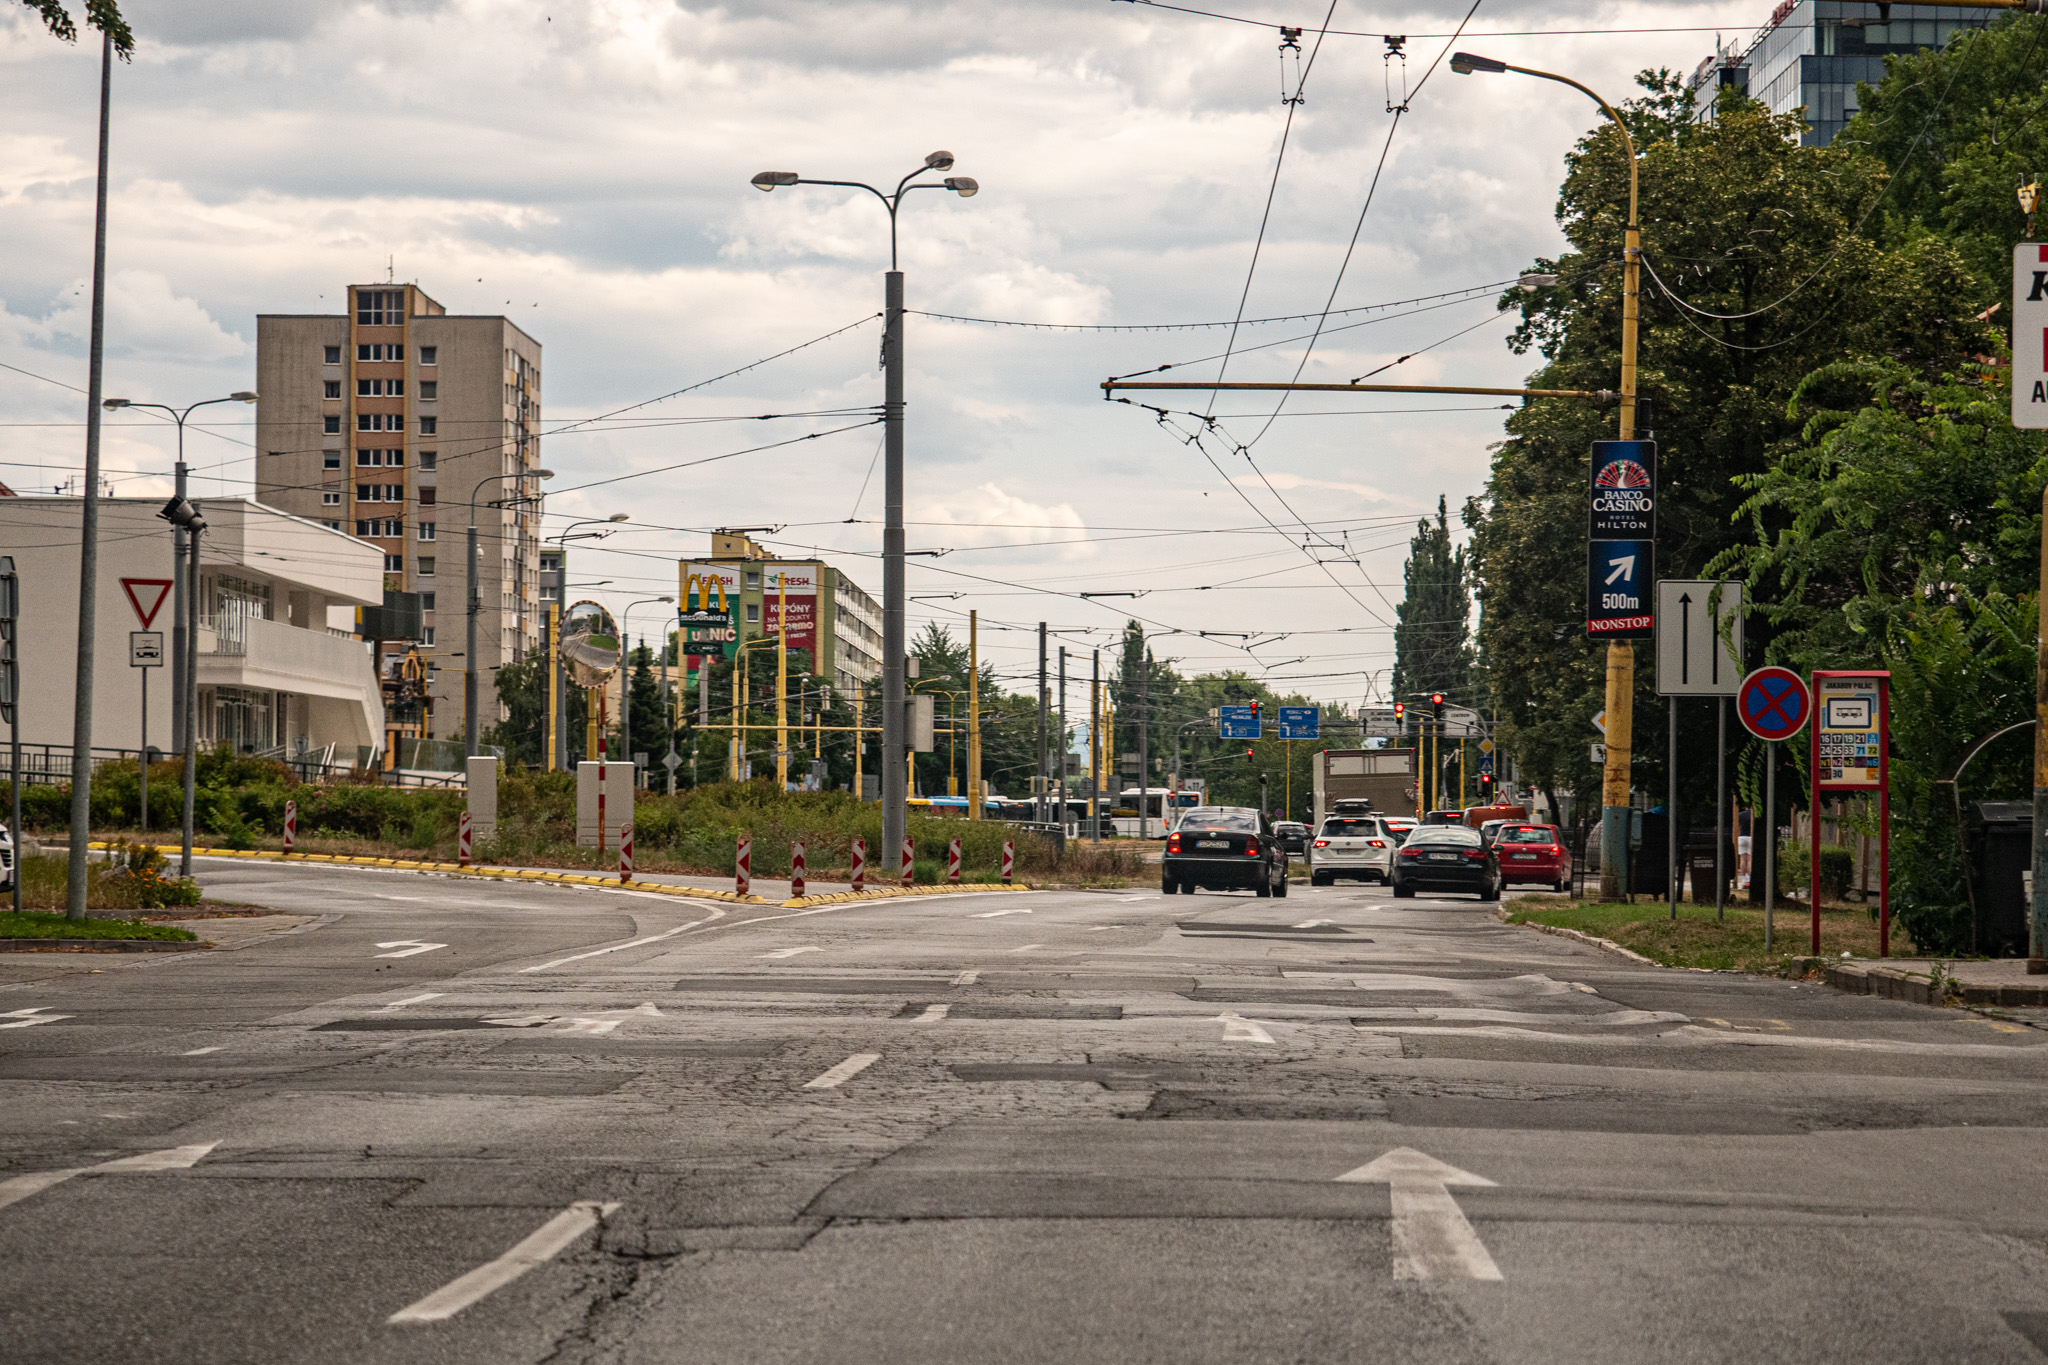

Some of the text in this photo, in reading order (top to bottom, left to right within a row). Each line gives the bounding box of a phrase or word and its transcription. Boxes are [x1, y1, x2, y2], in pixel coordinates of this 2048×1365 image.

[1604, 490, 1643, 500] BANCO
[1592, 498, 1653, 512] CASINO
[1597, 521, 1647, 529] HILTON
[1602, 593, 1639, 609] 500m
[766, 621, 814, 632] ZAARMO
[1591, 616, 1650, 631] NONSTOP
[1821, 735, 1830, 743] 16
[1833, 735, 1841, 743] 17
[1844, 735, 1853, 743] 19
[1856, 735, 1865, 743] 21
[1833, 770, 1842, 778] 30
